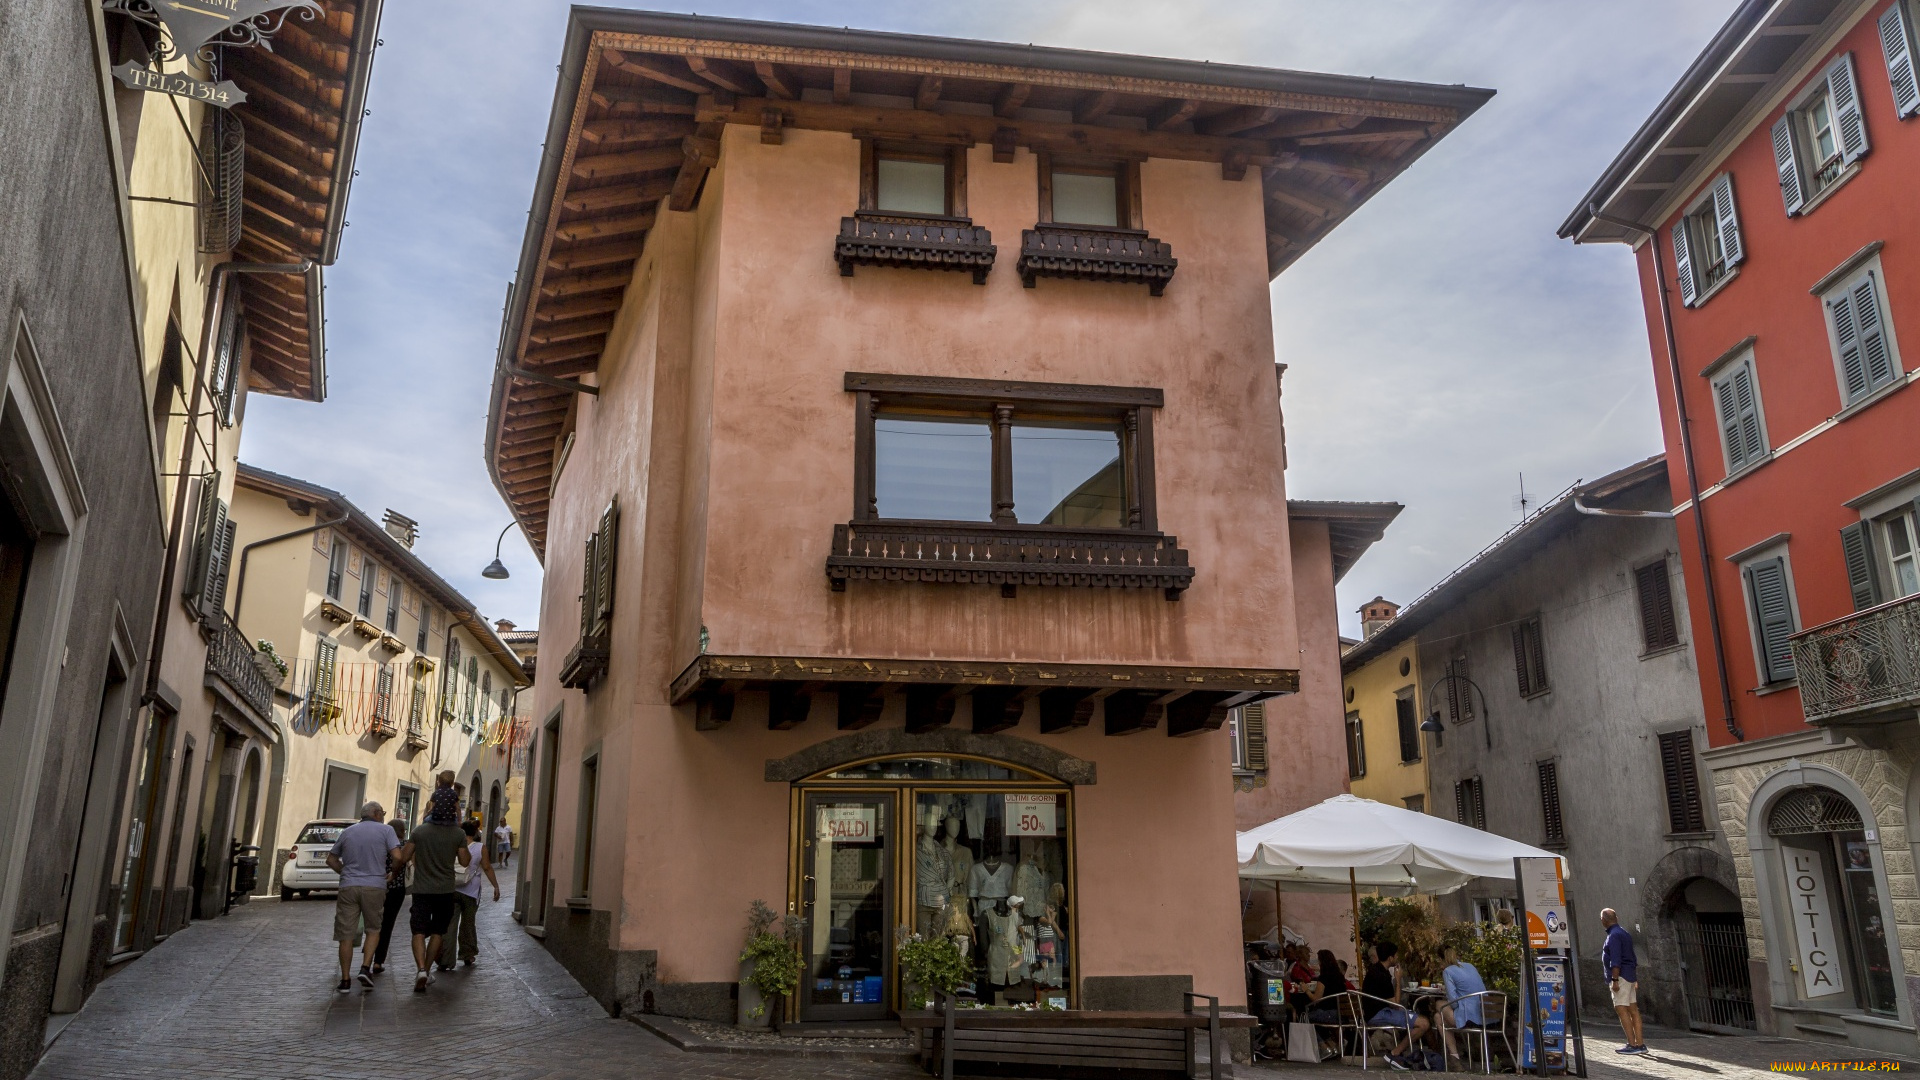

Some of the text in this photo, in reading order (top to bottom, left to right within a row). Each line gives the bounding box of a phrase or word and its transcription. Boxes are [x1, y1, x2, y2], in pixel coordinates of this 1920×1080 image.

[828, 820, 869, 837] SALDI
[1017, 814, 1046, 832] -50%
[1794, 856, 1833, 987] L'OTTICA
